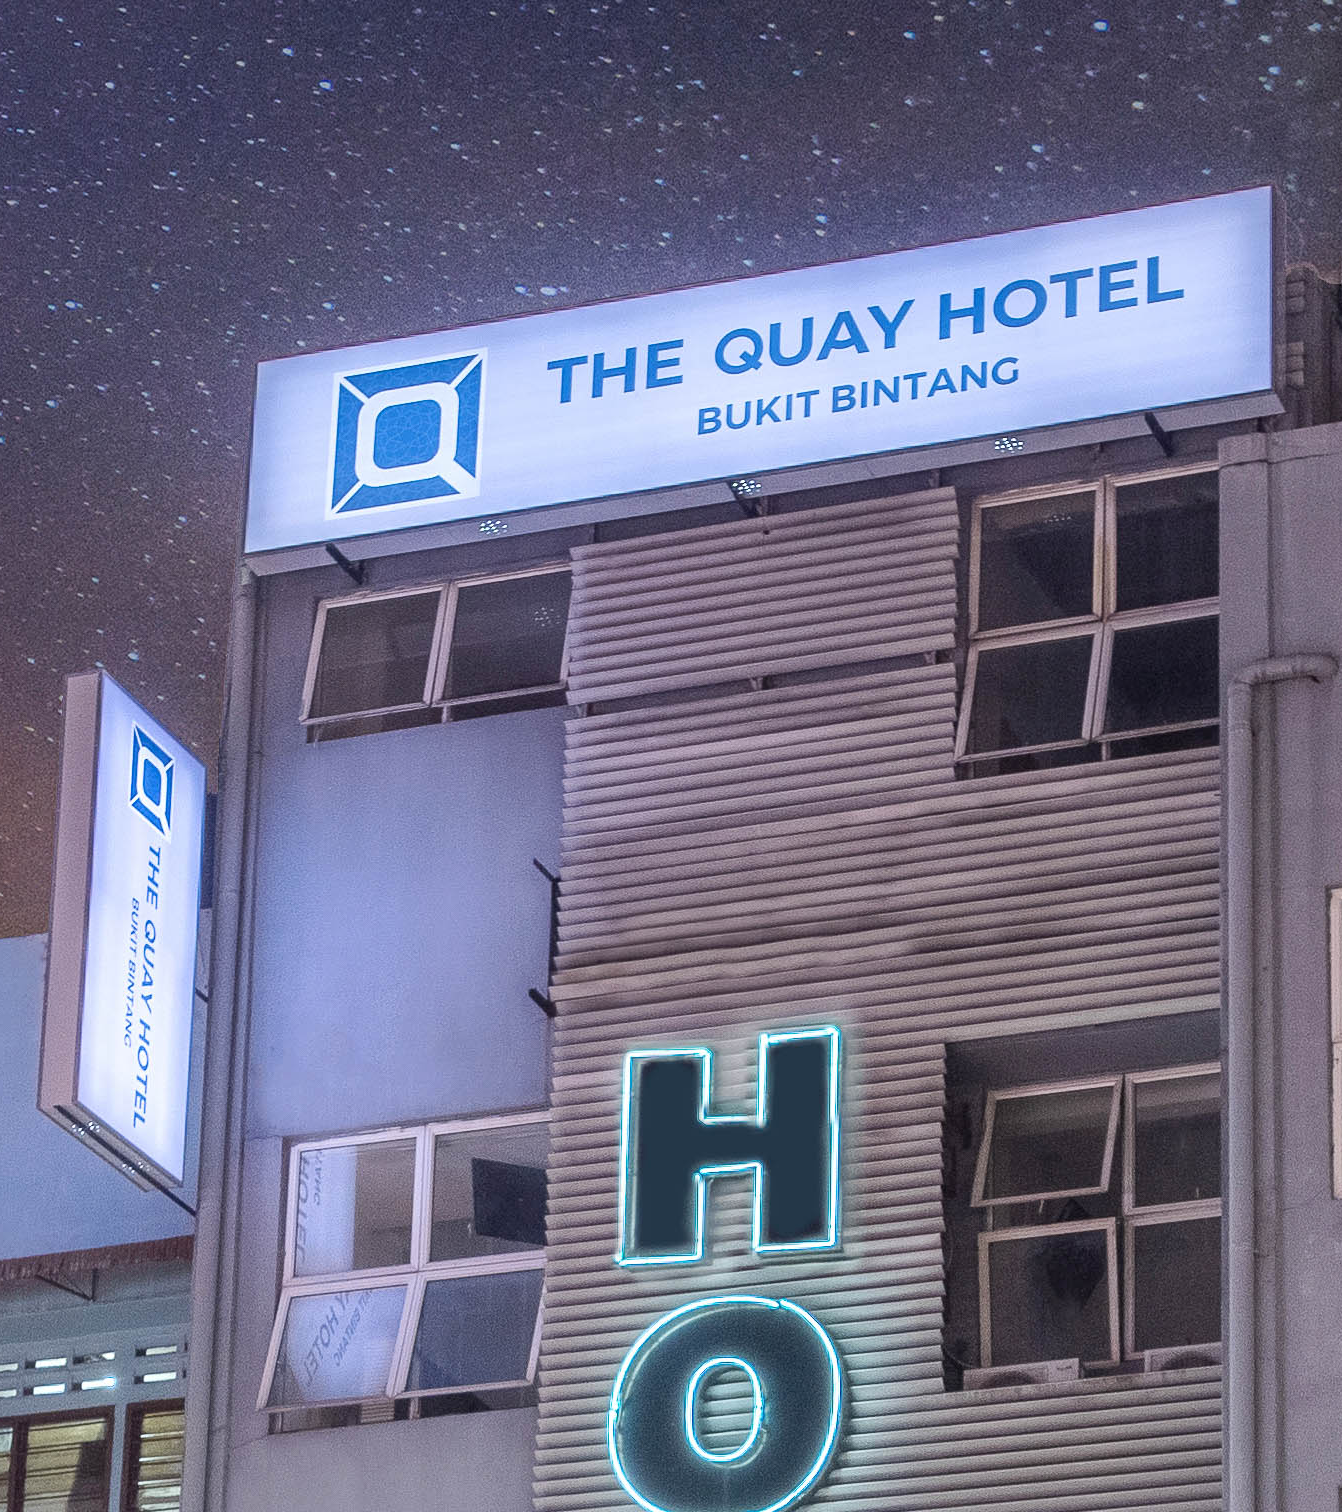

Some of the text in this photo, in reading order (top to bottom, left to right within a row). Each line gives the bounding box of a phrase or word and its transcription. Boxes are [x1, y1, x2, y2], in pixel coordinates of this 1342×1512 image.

[547, 255, 1186, 404] THE QUAY HOTEL
[697, 357, 1021, 436] BUKIT BINTANG
[124, 897, 139, 1047] BUKIT BINTANG
[133, 846, 160, 1128] THE QUAY HOTEL
